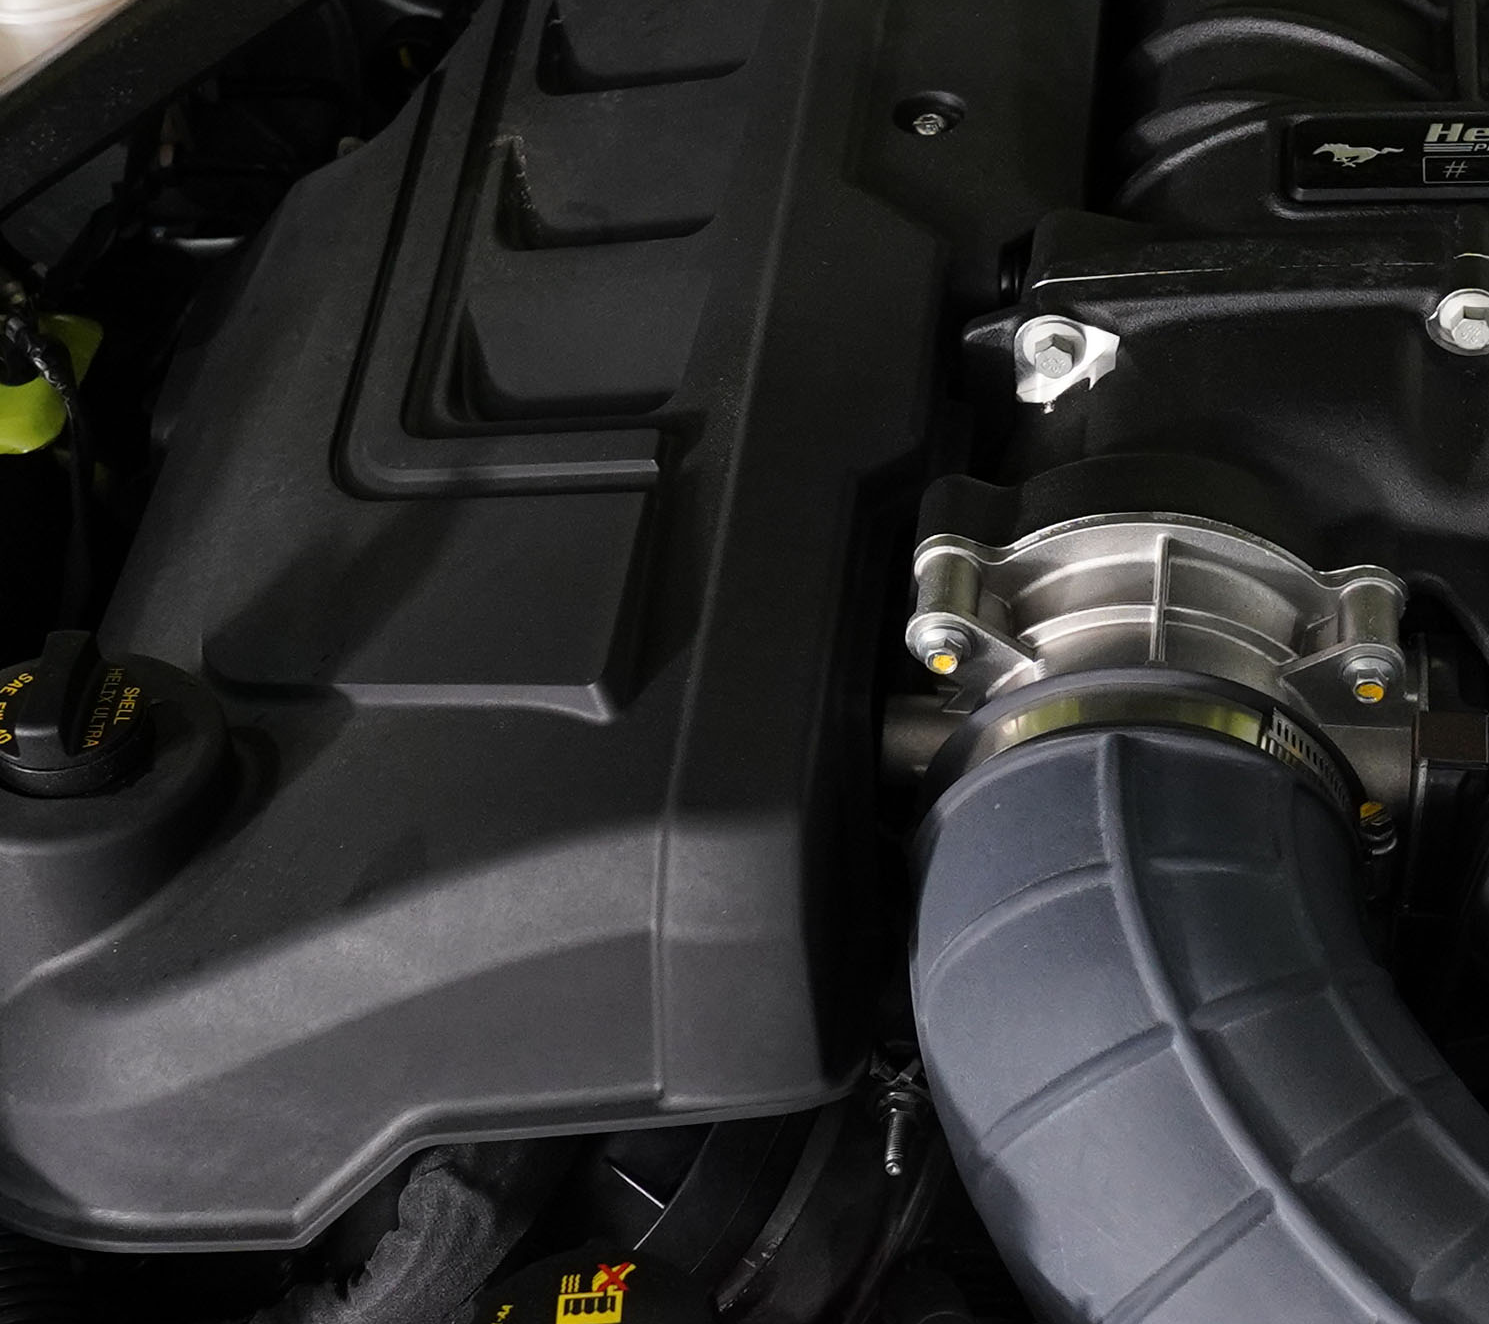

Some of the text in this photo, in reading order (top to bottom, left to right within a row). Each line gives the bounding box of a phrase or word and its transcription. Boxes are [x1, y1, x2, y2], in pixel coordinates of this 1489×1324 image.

[1442, 161, 1468, 179] #
[0, 672, 34, 697] SAE
[82, 668, 126, 749] HELIX ULTRA
[113, 686, 141, 725] SHELL
